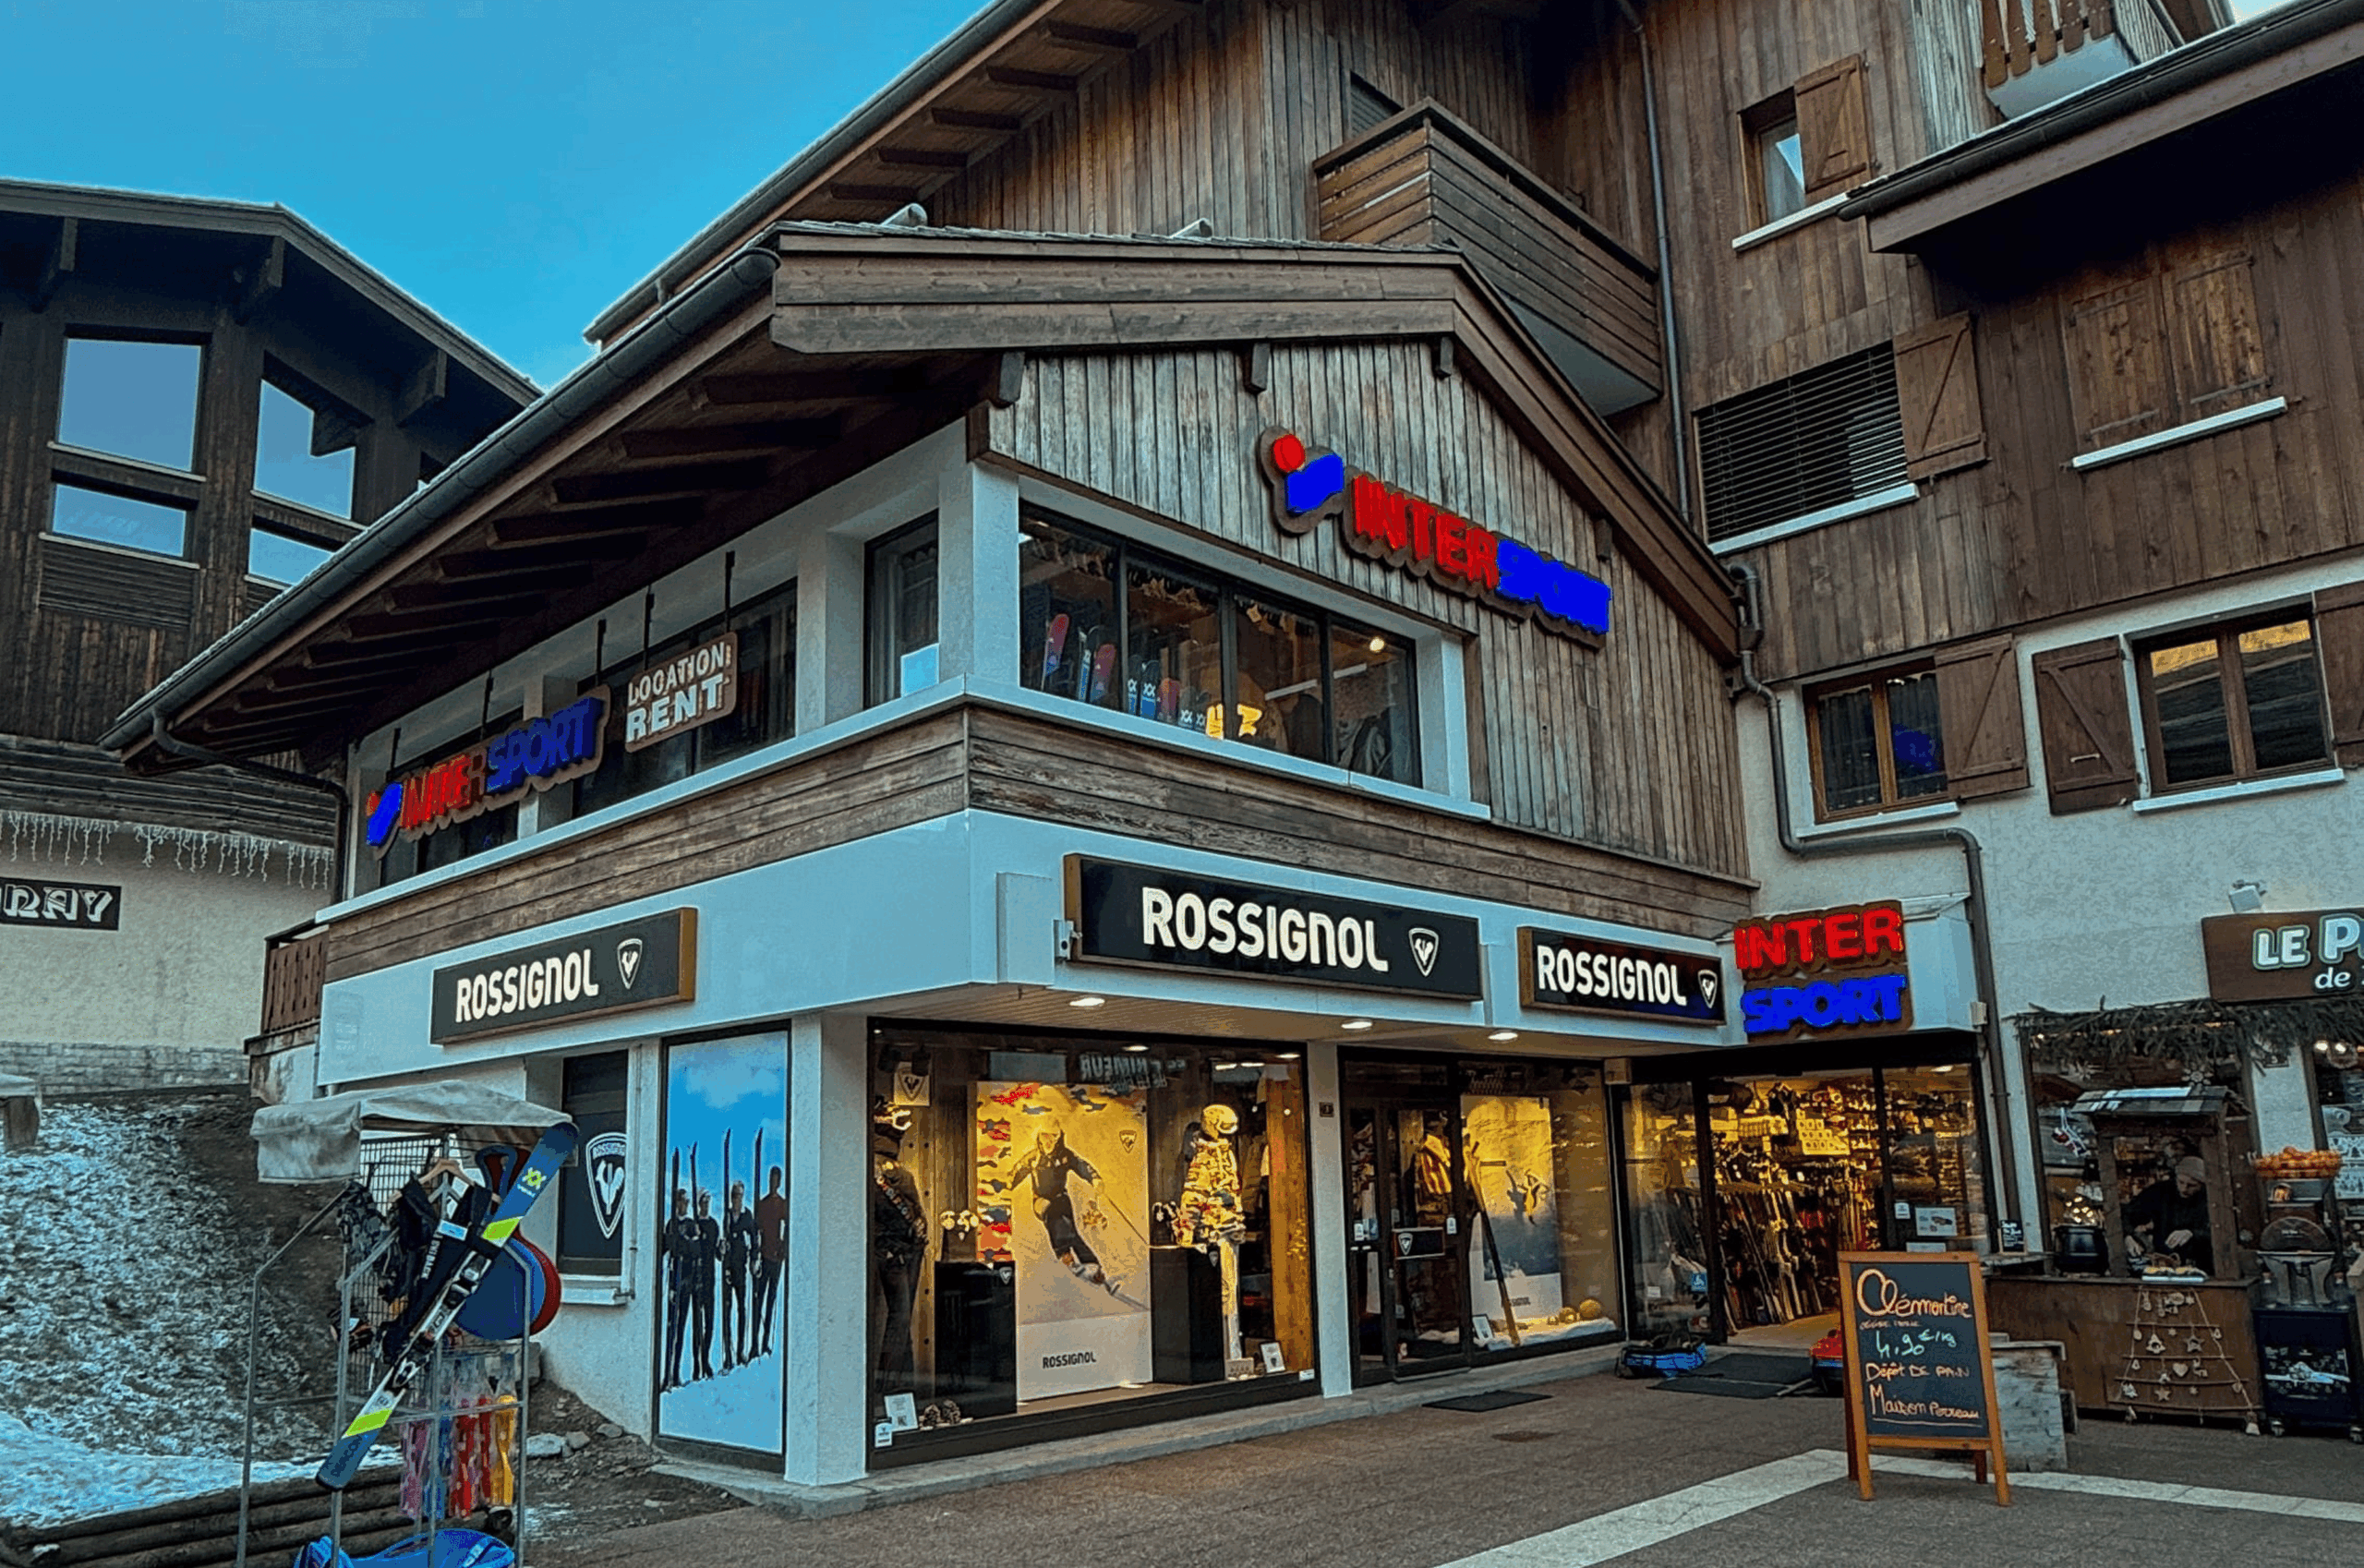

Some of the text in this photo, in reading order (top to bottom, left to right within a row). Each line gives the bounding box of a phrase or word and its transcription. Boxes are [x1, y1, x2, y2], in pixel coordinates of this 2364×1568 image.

[1351, 474, 1612, 635] INTER
[628, 642, 728, 706] LOCATION
[626, 673, 725, 743] RENT
[0, 883, 113, 922] RAY
[1141, 886, 1390, 972] ROSSIGNOL
[1734, 908, 1904, 970] INTER
[2256, 913, 2364, 968] LE P
[455, 948, 599, 1023] ROSSIGNOL
[1536, 944, 1687, 1007] ROSSIGNOL
[1741, 973, 1908, 1033] SPORT
[2314, 966, 2351, 988] de
[1043, 1351, 1097, 1369] ROSSIGNOL
[1869, 1383, 1927, 1416] Maison
